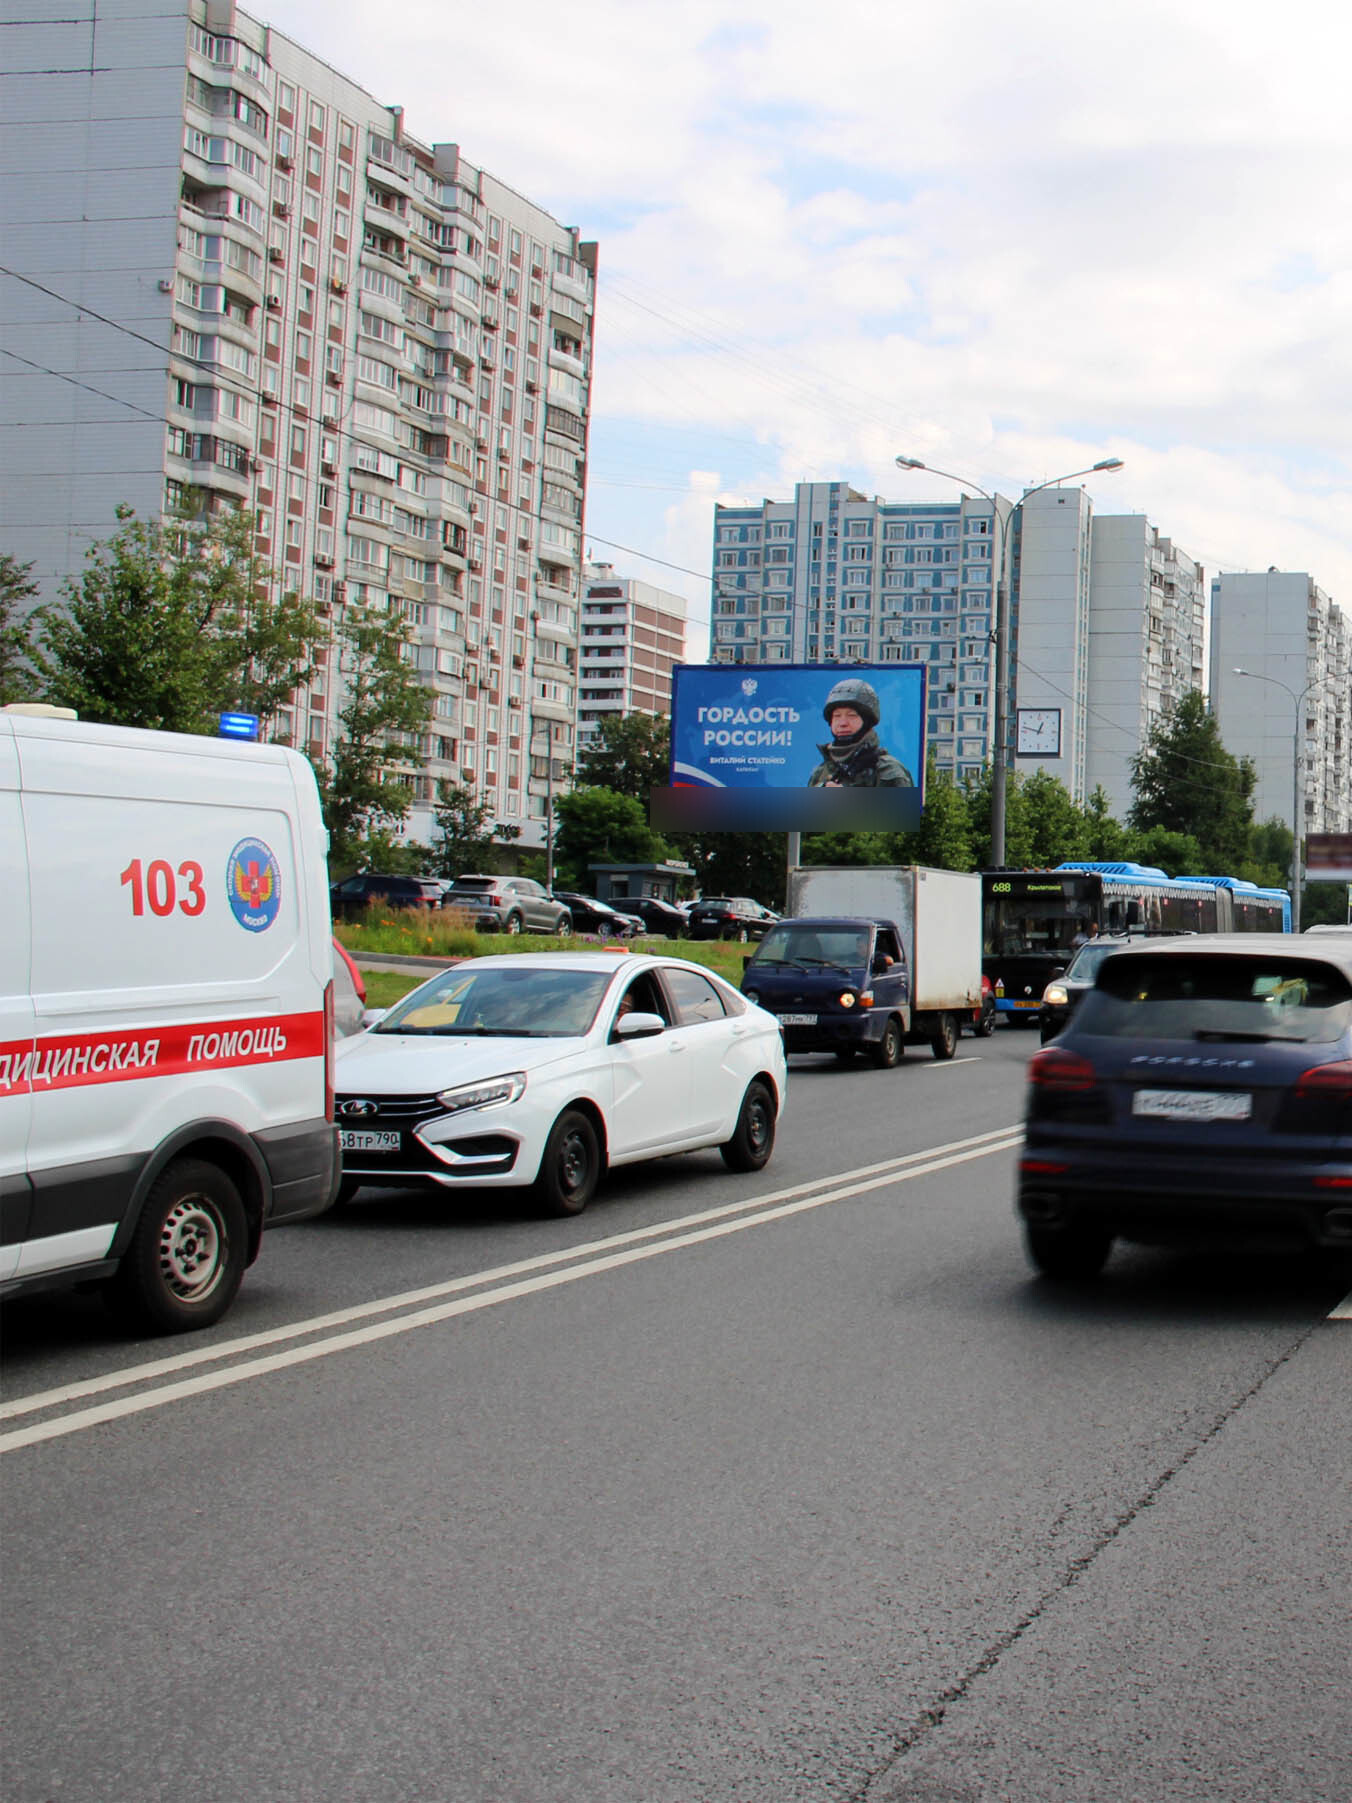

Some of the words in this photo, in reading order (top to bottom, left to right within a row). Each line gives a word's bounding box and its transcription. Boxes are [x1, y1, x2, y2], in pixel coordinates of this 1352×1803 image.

[697, 707, 800, 725] ГОРДОСТЬ
[703, 729, 793, 747] РОССИИ!
[120, 858, 207, 917] 103
[992, 882, 1012, 893] 688
[187, 1026, 287, 1063] ПОМОЩЬ
